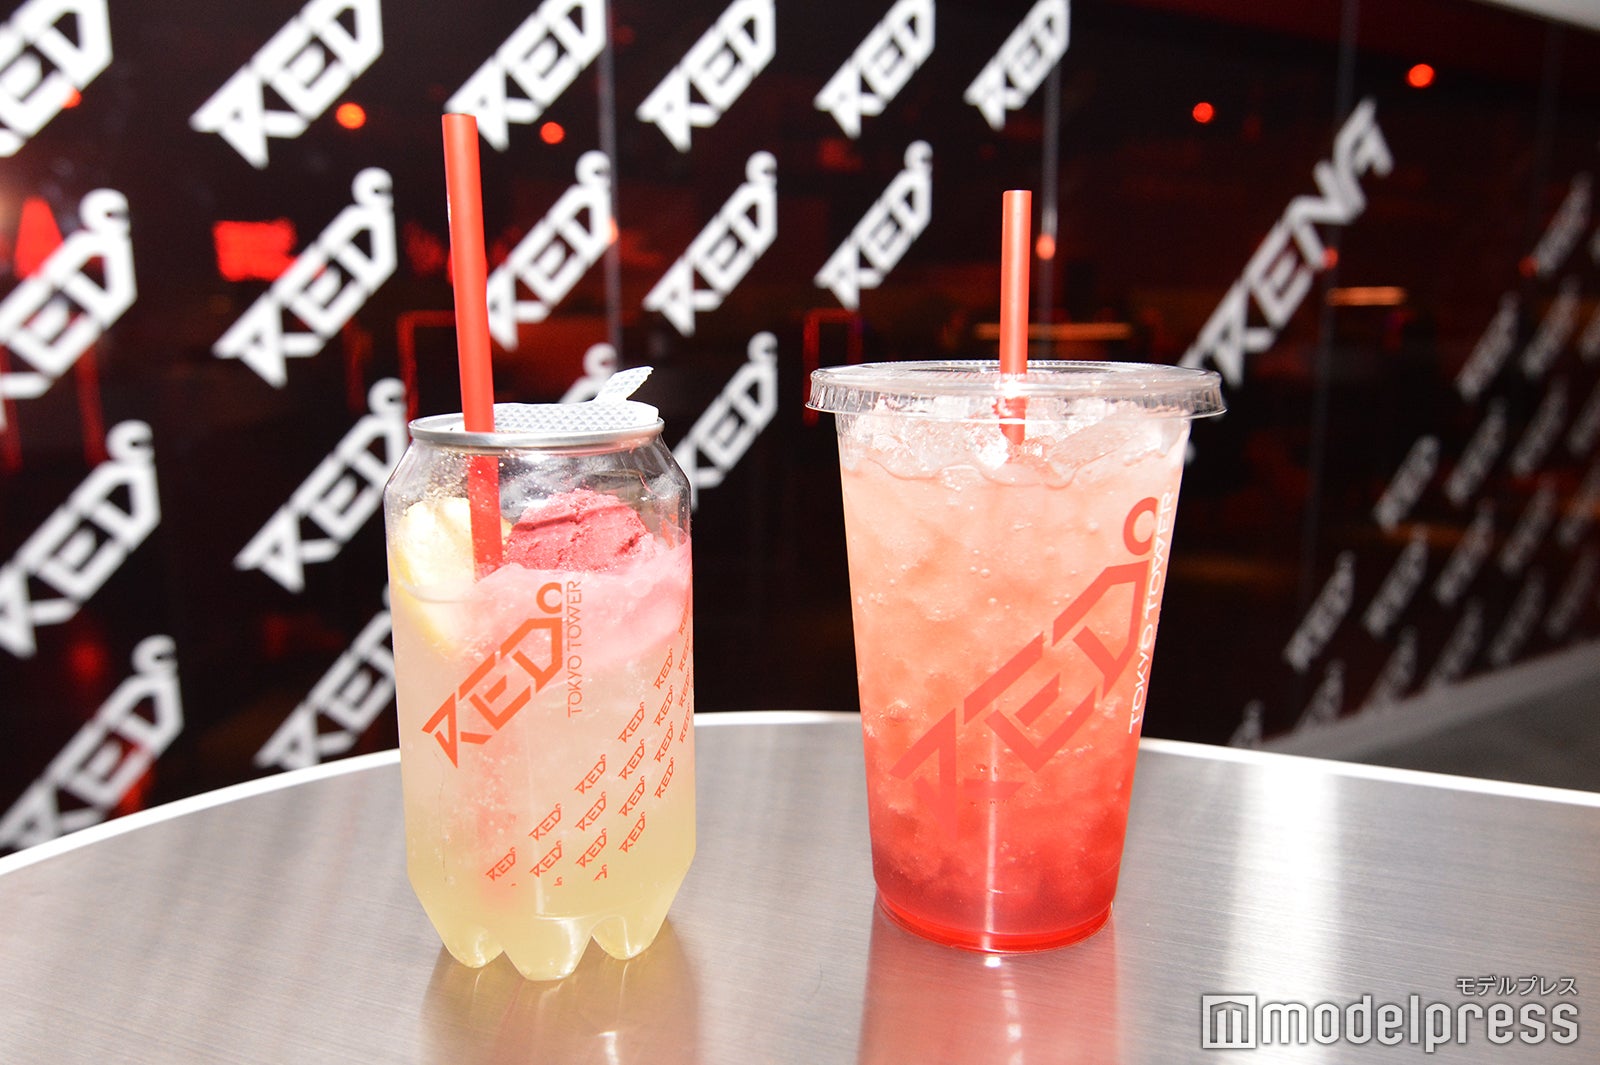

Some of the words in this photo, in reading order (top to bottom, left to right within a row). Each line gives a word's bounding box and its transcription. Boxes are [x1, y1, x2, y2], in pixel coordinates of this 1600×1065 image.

[566, 579, 583, 652] TOWER
[1128, 623, 1154, 735] TOKYO
[1144, 488, 1175, 620] TOWER
[566, 654, 583, 718] TOKYO
